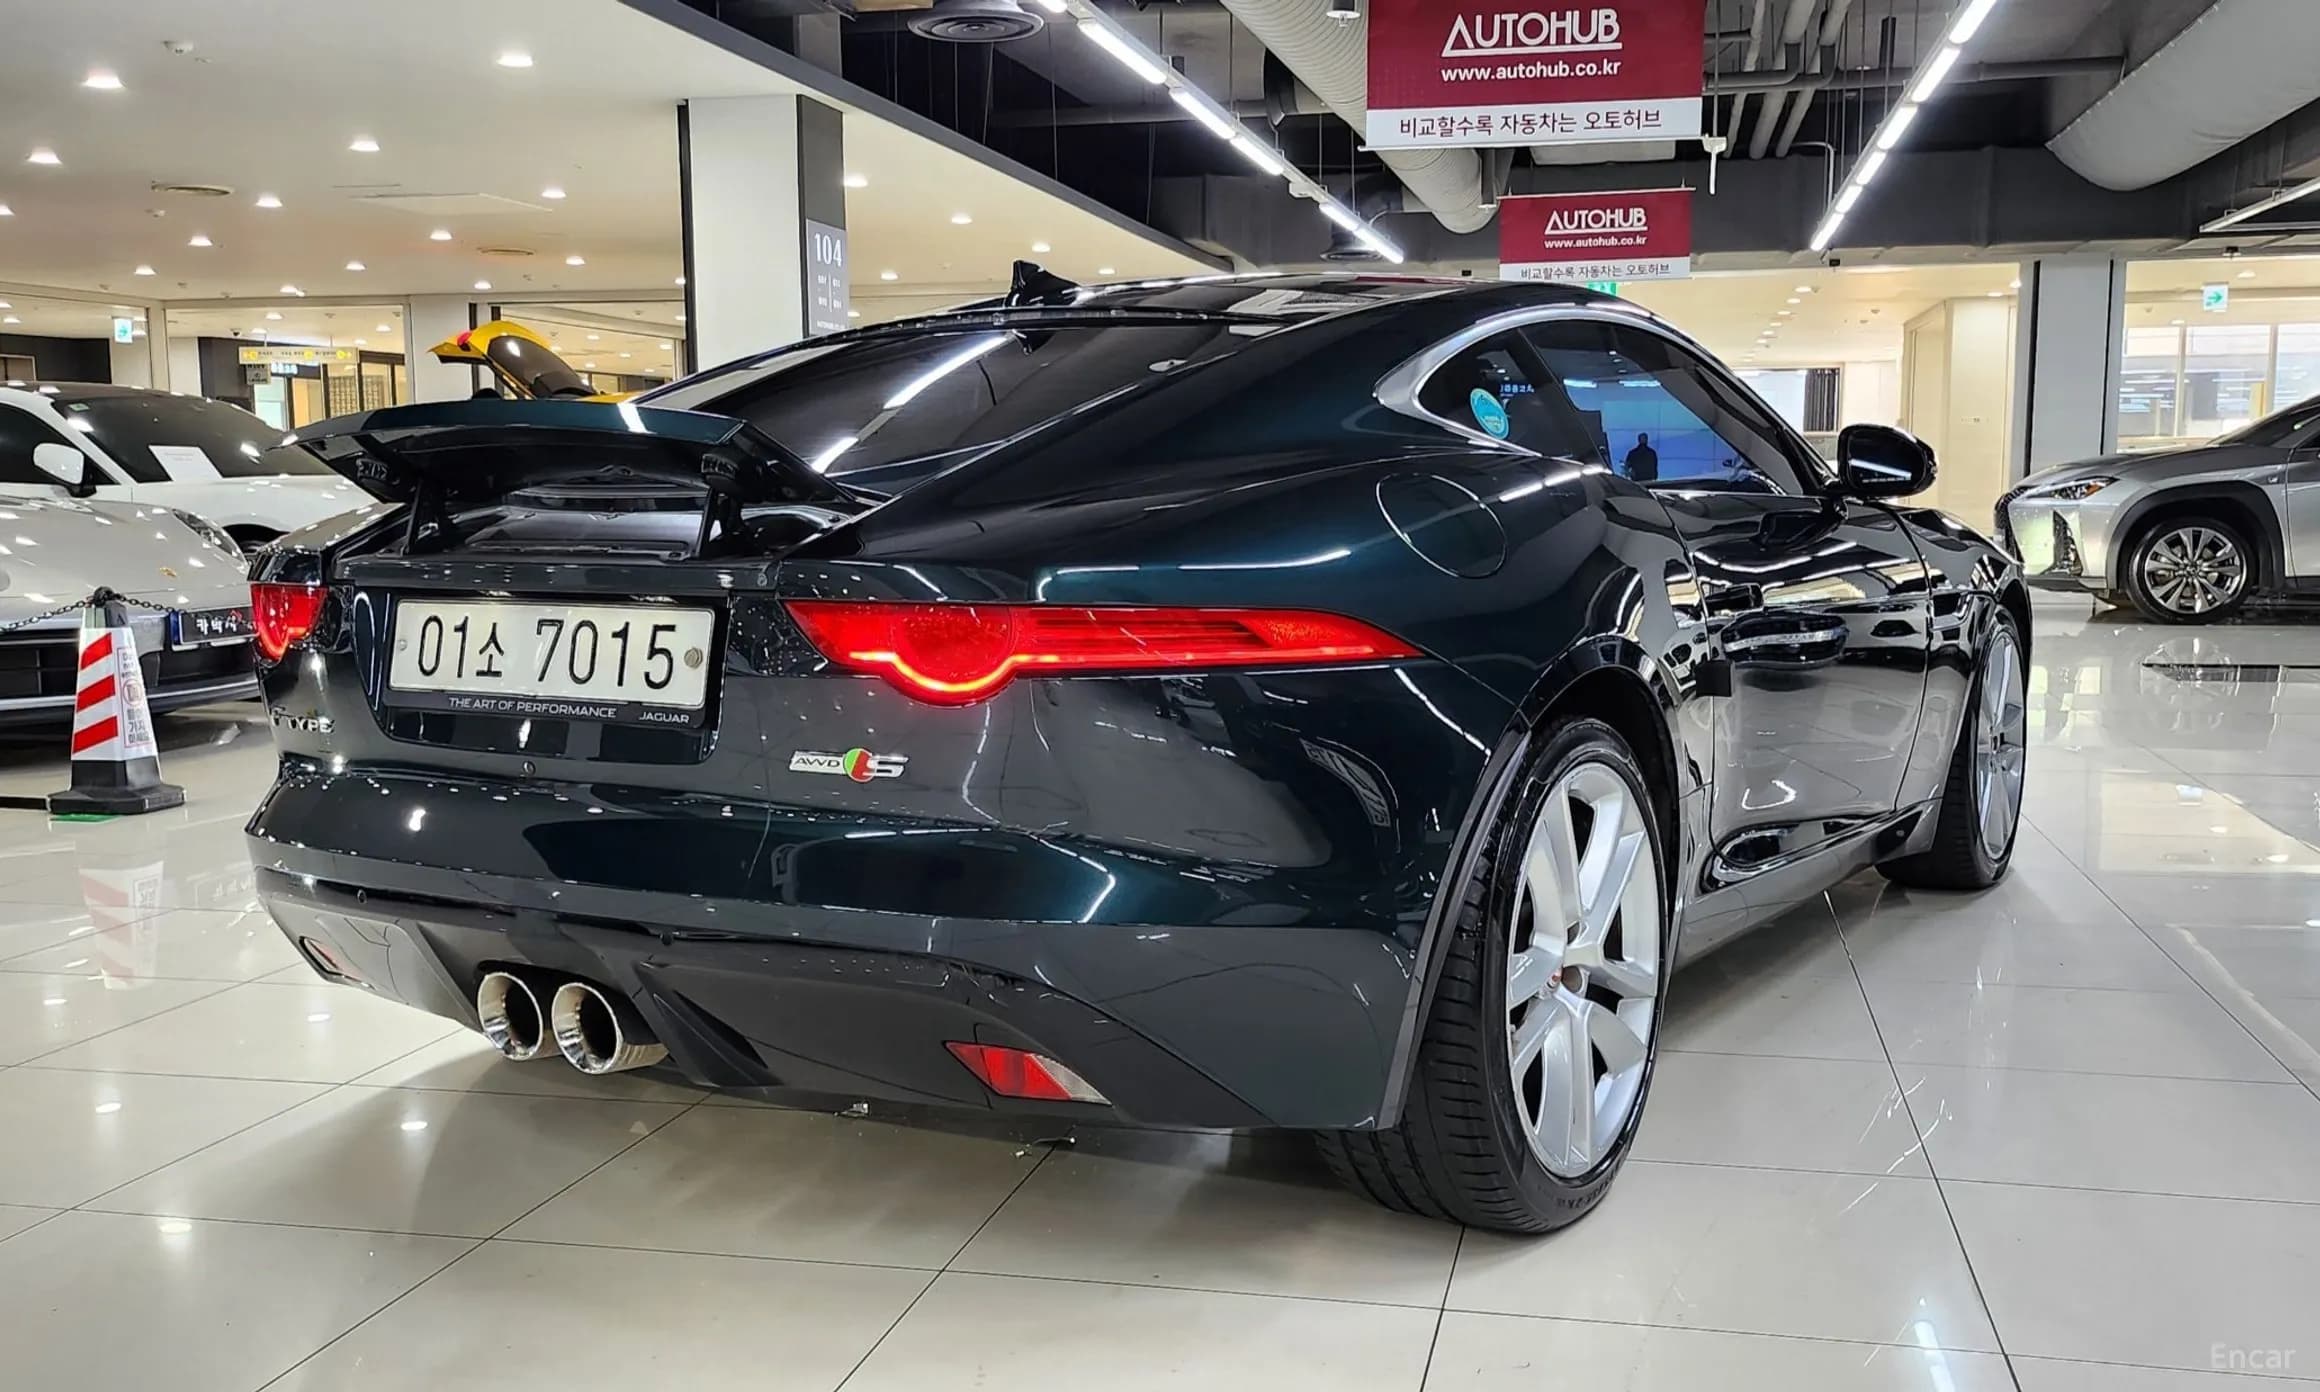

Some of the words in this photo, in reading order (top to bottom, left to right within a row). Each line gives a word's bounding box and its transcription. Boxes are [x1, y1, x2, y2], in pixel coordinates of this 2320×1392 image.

[1441, 8, 1622, 57] AUTOHUB
[1441, 59, 1622, 82] www.autohub.co.kr
[1400, 115, 1493, 138] 비교할수록
[1500, 112, 1577, 135] 자동차는
[1583, 109, 1662, 131] 오토허브
[1545, 207, 1648, 235] AUTOHUB
[814, 232, 842, 267] 104
[1544, 235, 1647, 249] www.autohub.co.kr
[1521, 267, 1575, 280] 비교할수록
[1579, 266, 1622, 279] 자동차는
[1626, 264, 1671, 276] 오토허브
[418, 615, 505, 678] 01소
[536, 619, 677, 690] 7015
[449, 697, 472, 709] THE
[472, 699, 497, 711] ART
[498, 701, 514, 711] OF
[517, 702, 617, 719] PERFORMANCE
[639, 711, 690, 724] JAGUAR
[794, 757, 841, 768] AWD
